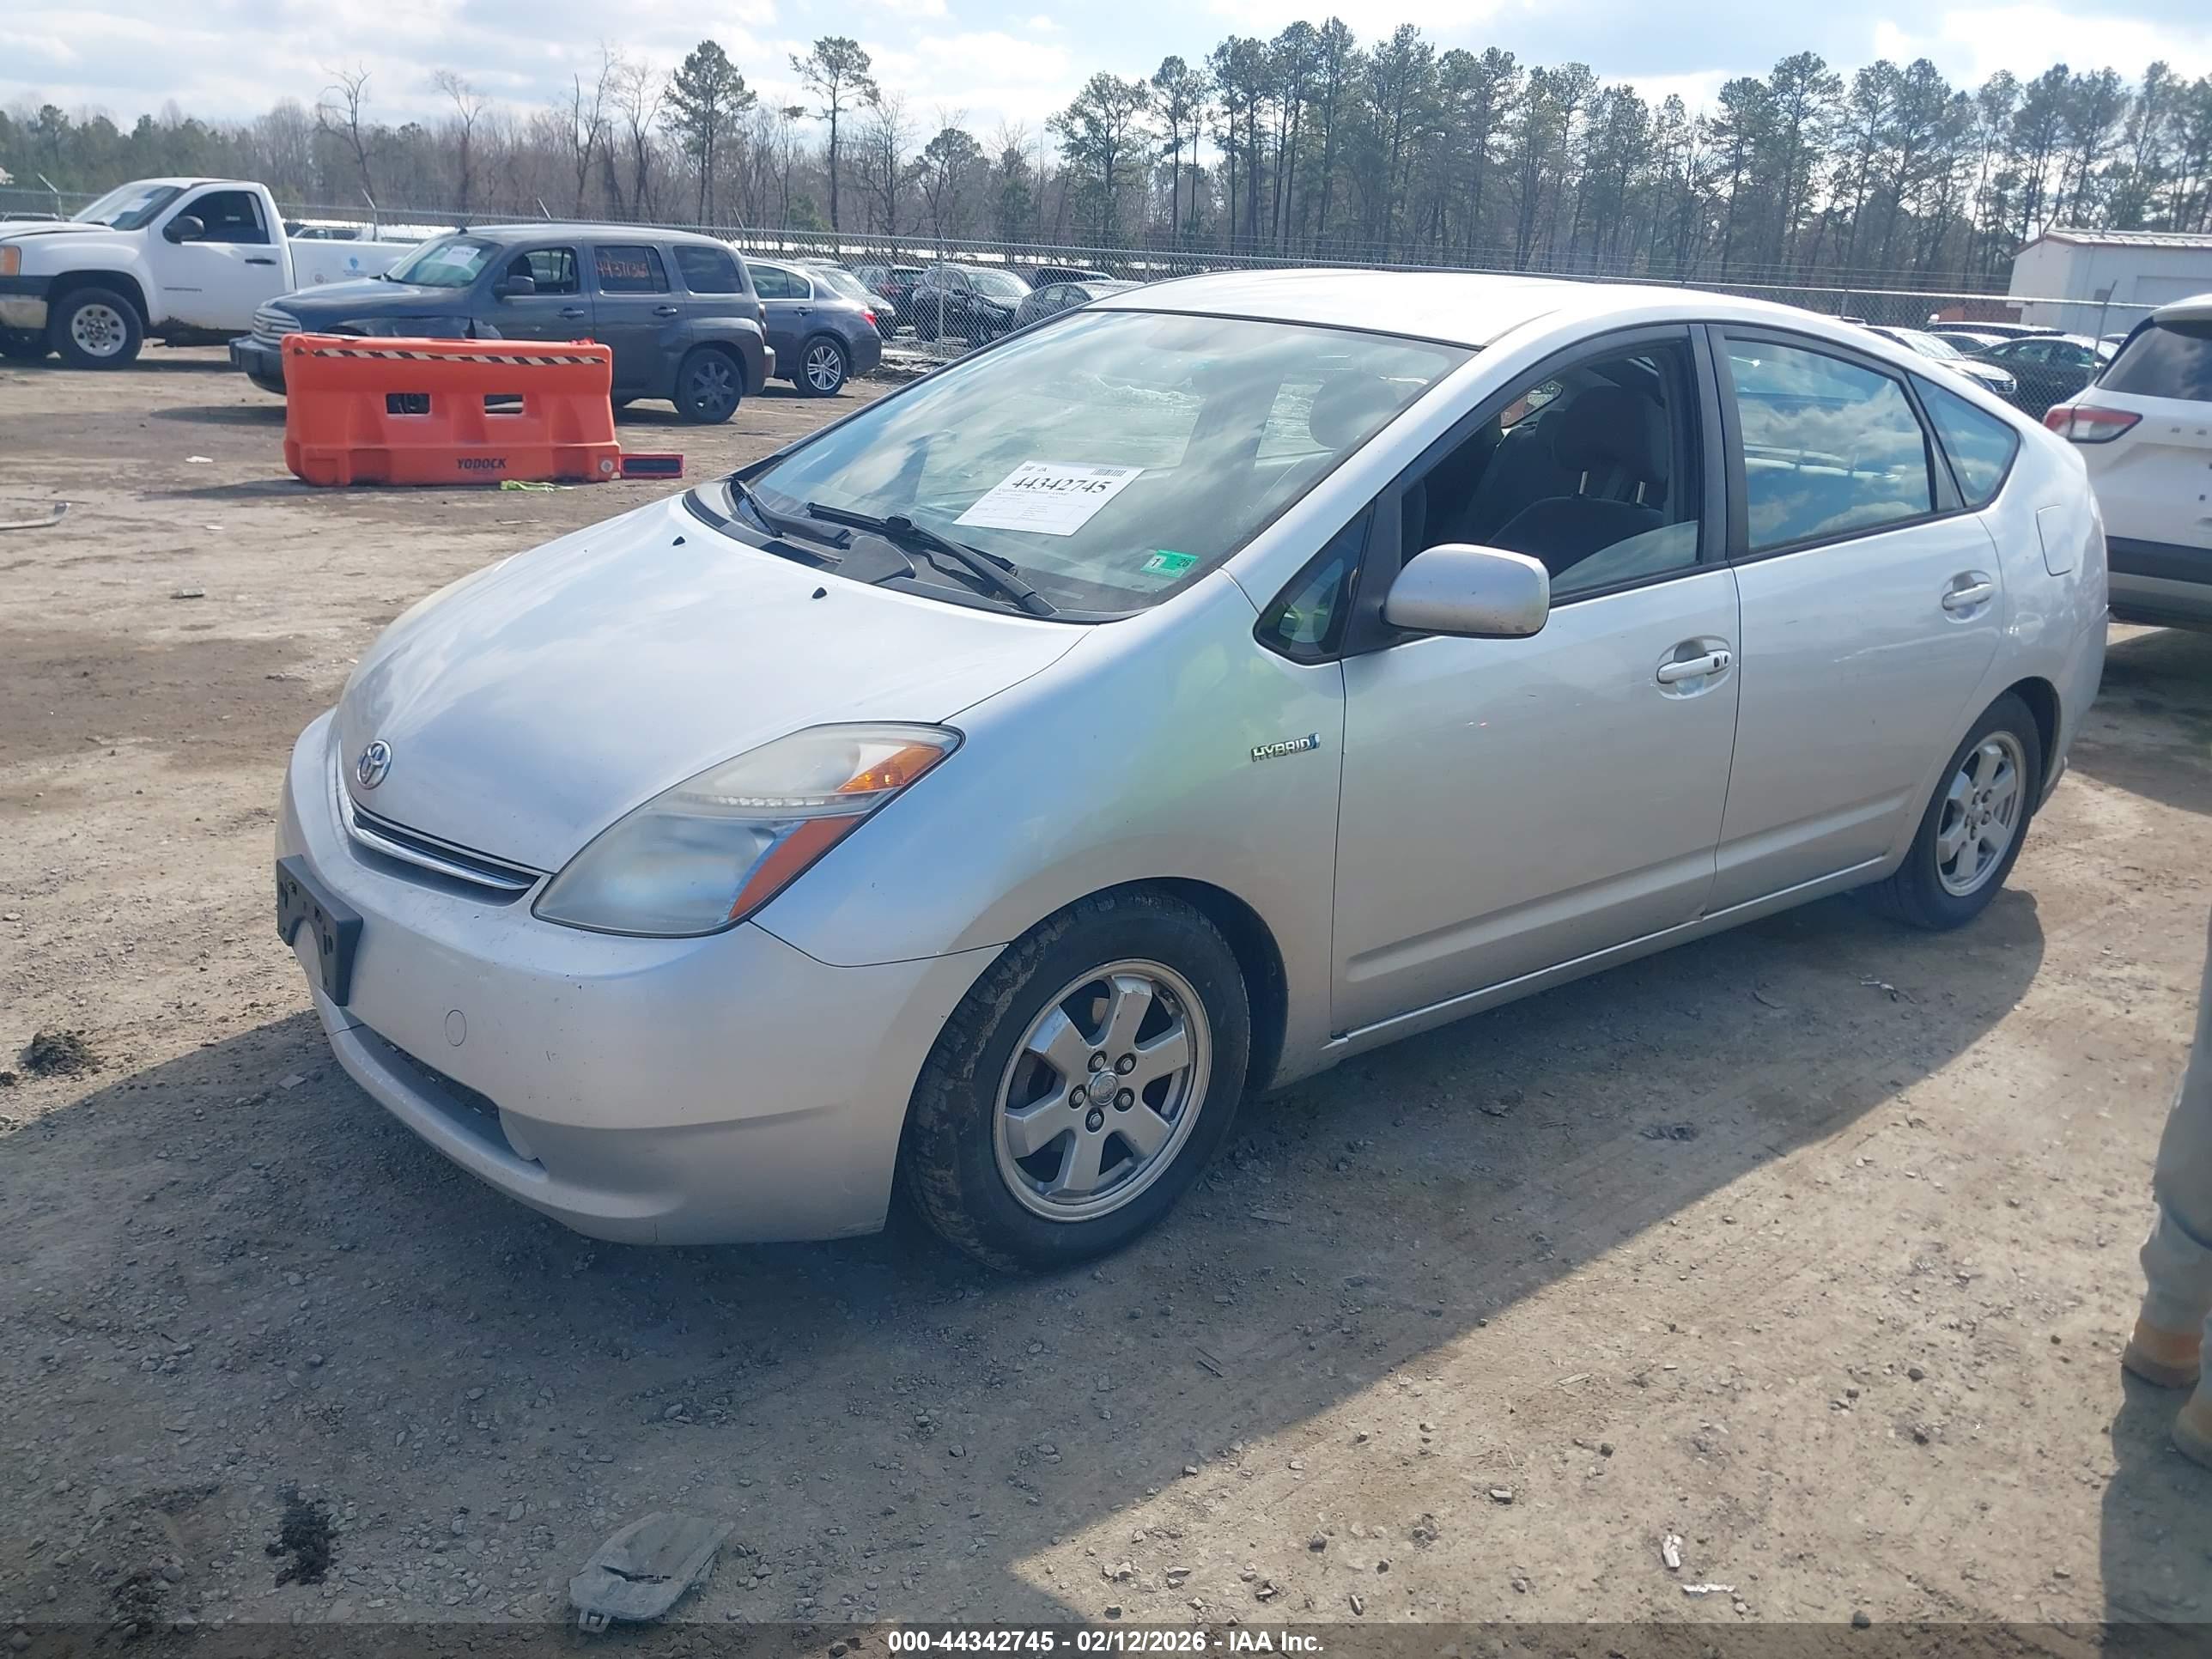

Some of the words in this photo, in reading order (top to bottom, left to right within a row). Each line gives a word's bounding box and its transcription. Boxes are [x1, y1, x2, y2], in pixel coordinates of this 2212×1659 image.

[457, 458, 507, 469] YODOCK
[1012, 476, 1114, 494] 44342745
[1251, 738, 1310, 762] HYBRID
